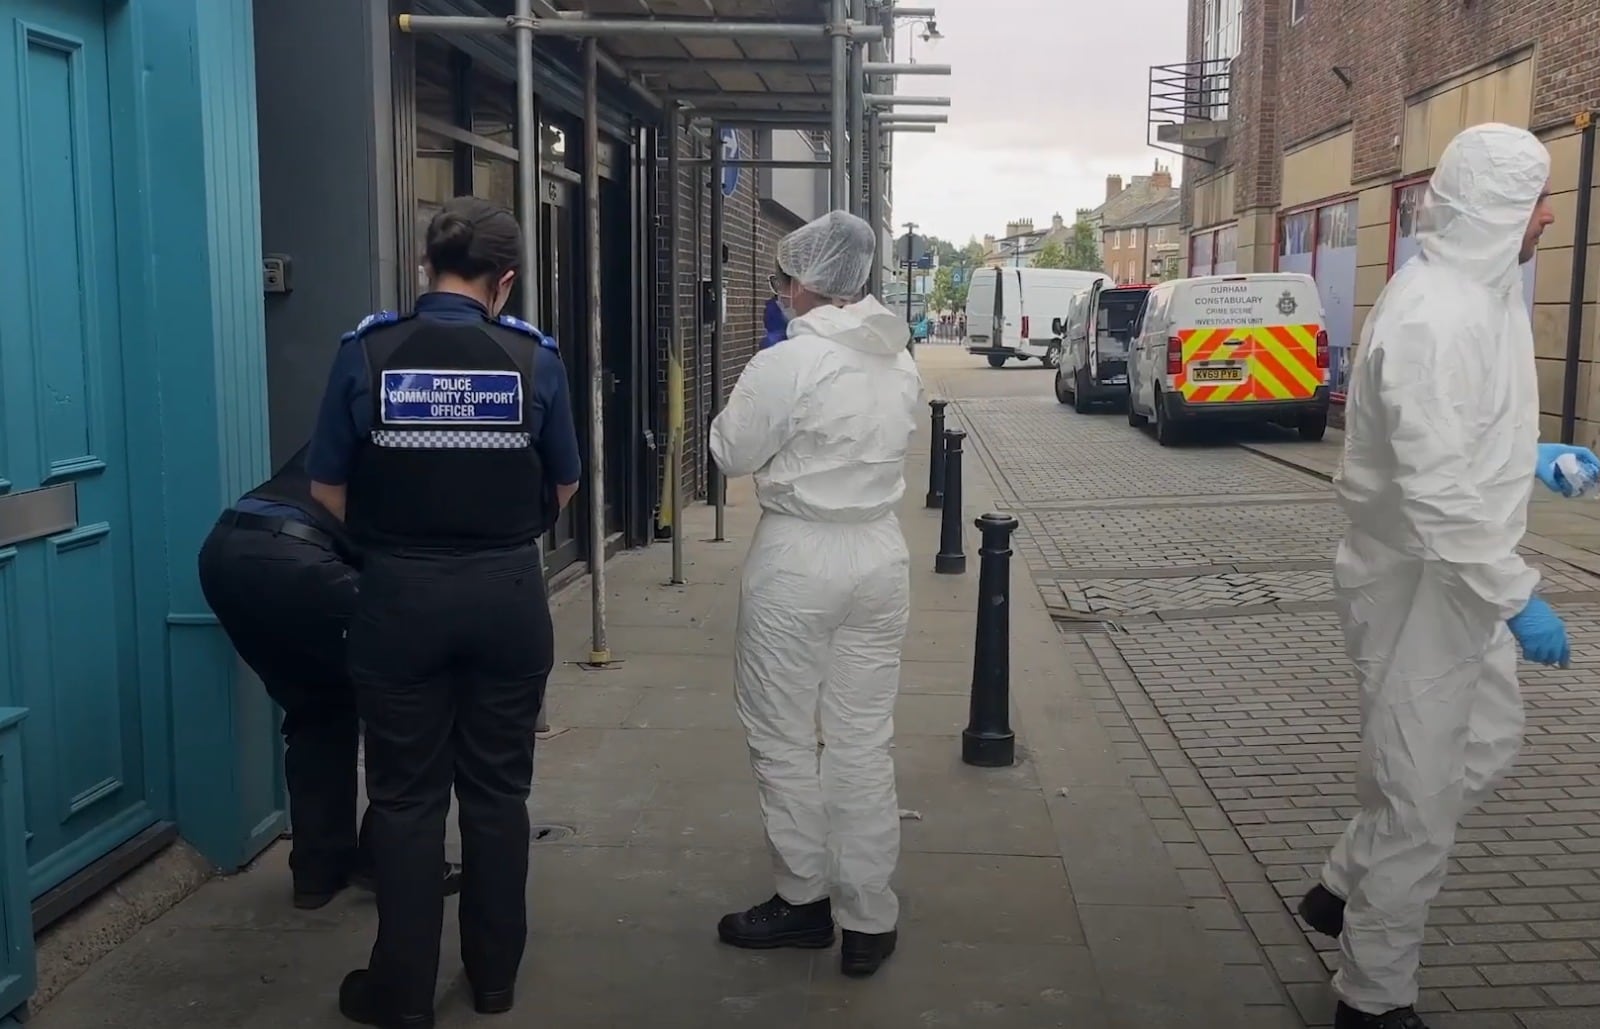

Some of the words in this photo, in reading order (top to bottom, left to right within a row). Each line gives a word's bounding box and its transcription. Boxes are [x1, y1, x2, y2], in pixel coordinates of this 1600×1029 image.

[1195, 296, 1263, 305] CONSTABULARY
[1248, 317, 1263, 325] UNIT
[1196, 369, 1219, 379] KV69
[1221, 369, 1238, 378] PYB
[433, 378, 472, 391] POLICE
[389, 391, 461, 404] COMMUNITY
[464, 392, 514, 404] SUPPORT
[430, 404, 475, 417] OFFICER
